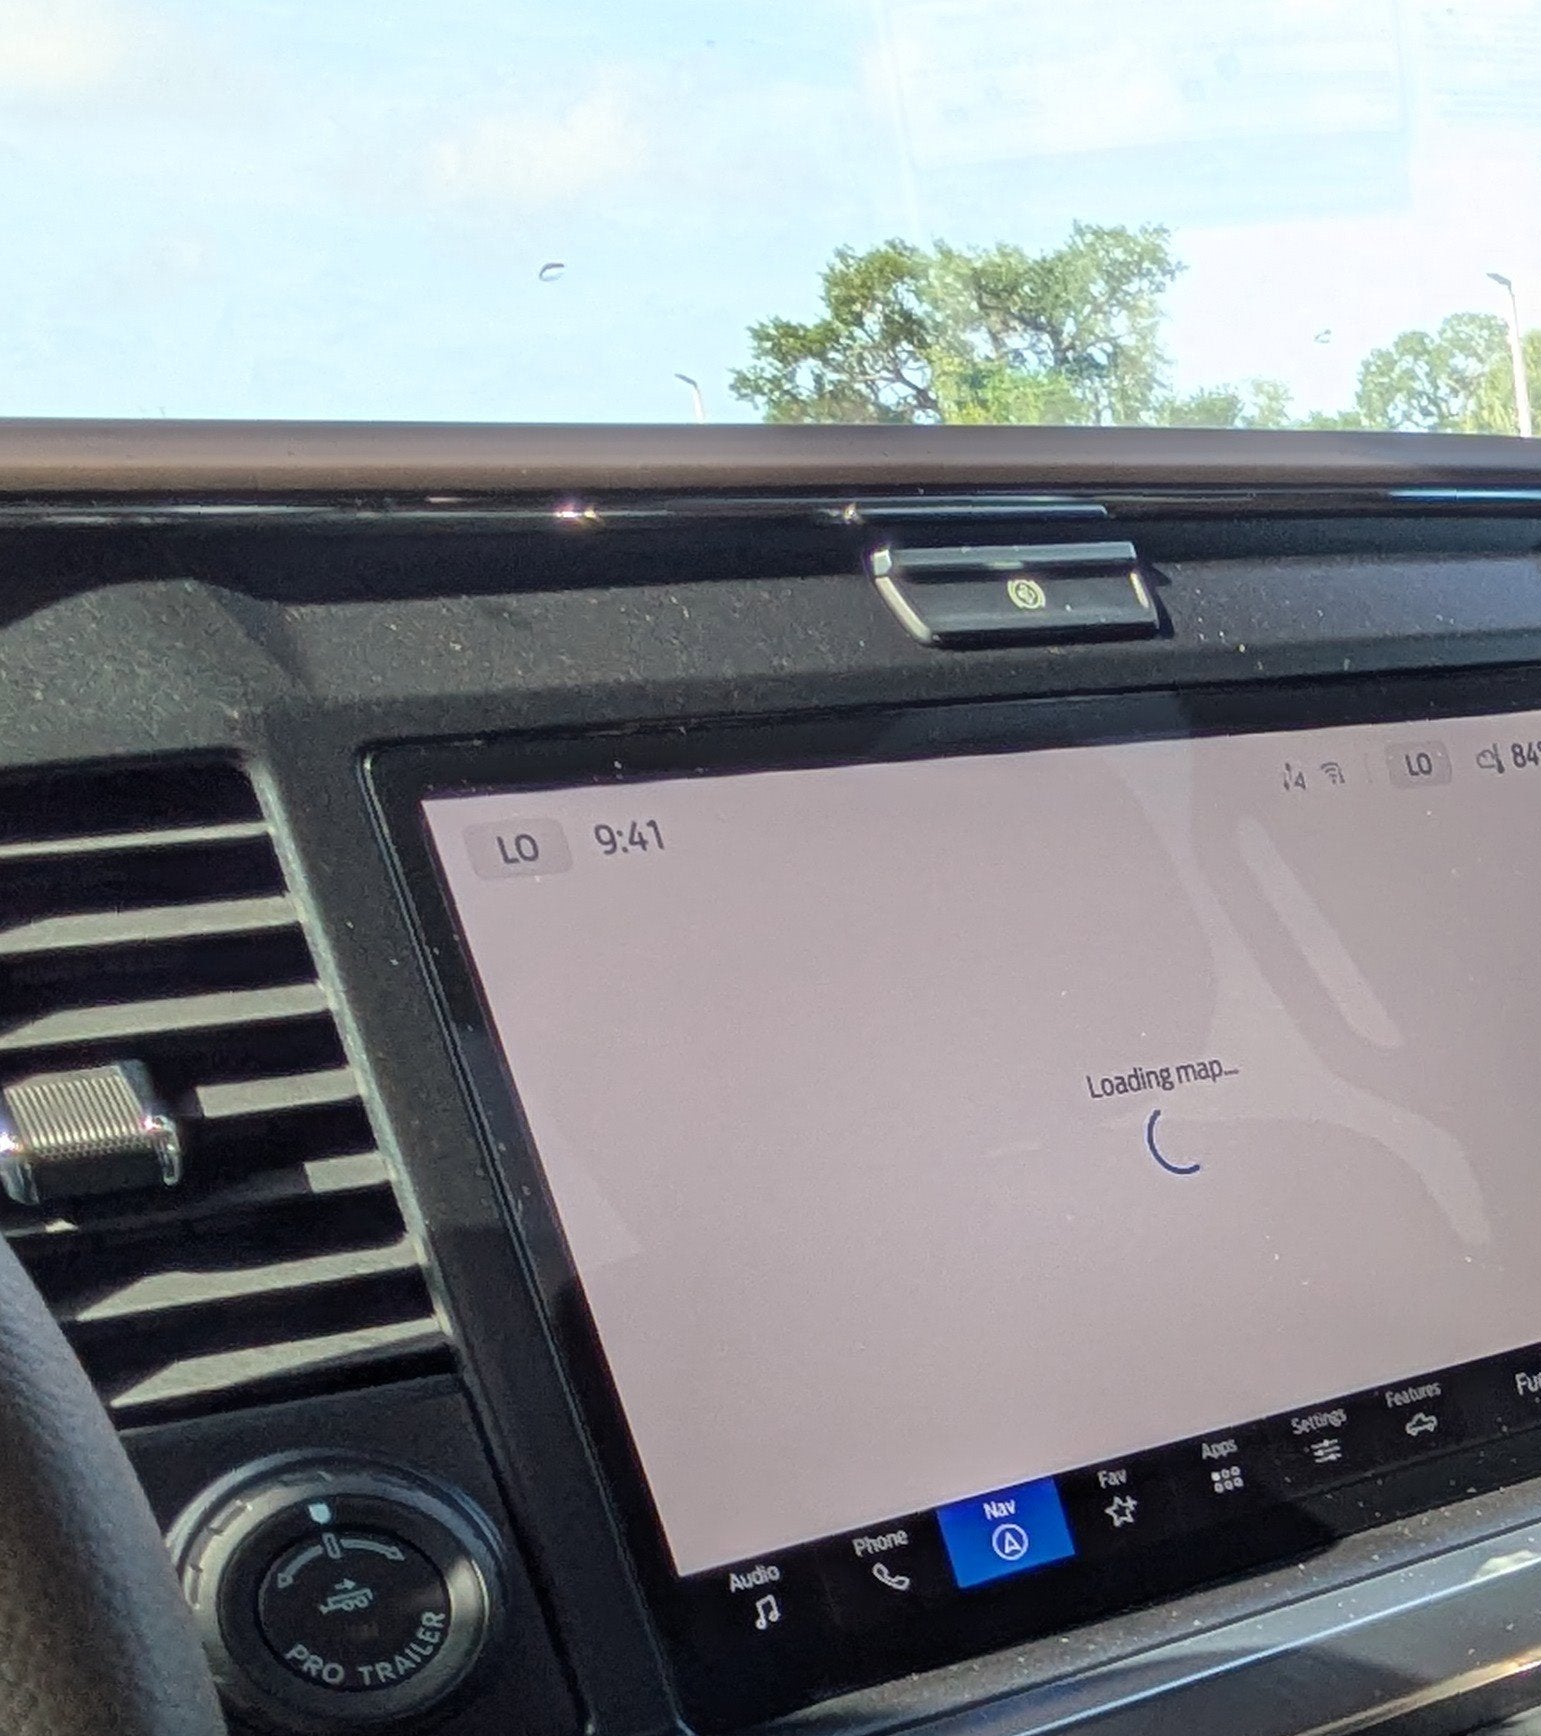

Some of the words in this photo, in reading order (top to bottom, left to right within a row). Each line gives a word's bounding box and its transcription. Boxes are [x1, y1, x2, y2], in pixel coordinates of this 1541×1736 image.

[1404, 752, 1433, 778] LO
[496, 833, 540, 864] LO
[594, 818, 666, 856] 9:41
[1086, 1066, 1175, 1100] Loading
[1384, 1380, 1441, 1409] Features
[1291, 1407, 1348, 1436] Settings
[1200, 1437, 1238, 1461] Apps
[1097, 1467, 1127, 1489] Fav
[982, 1498, 1017, 1521] Nav
[851, 1527, 909, 1557] Phone
[729, 1561, 781, 1593] Audio
[284, 1643, 345, 1686] PRO
[358, 1611, 445, 1686] TRAILER
